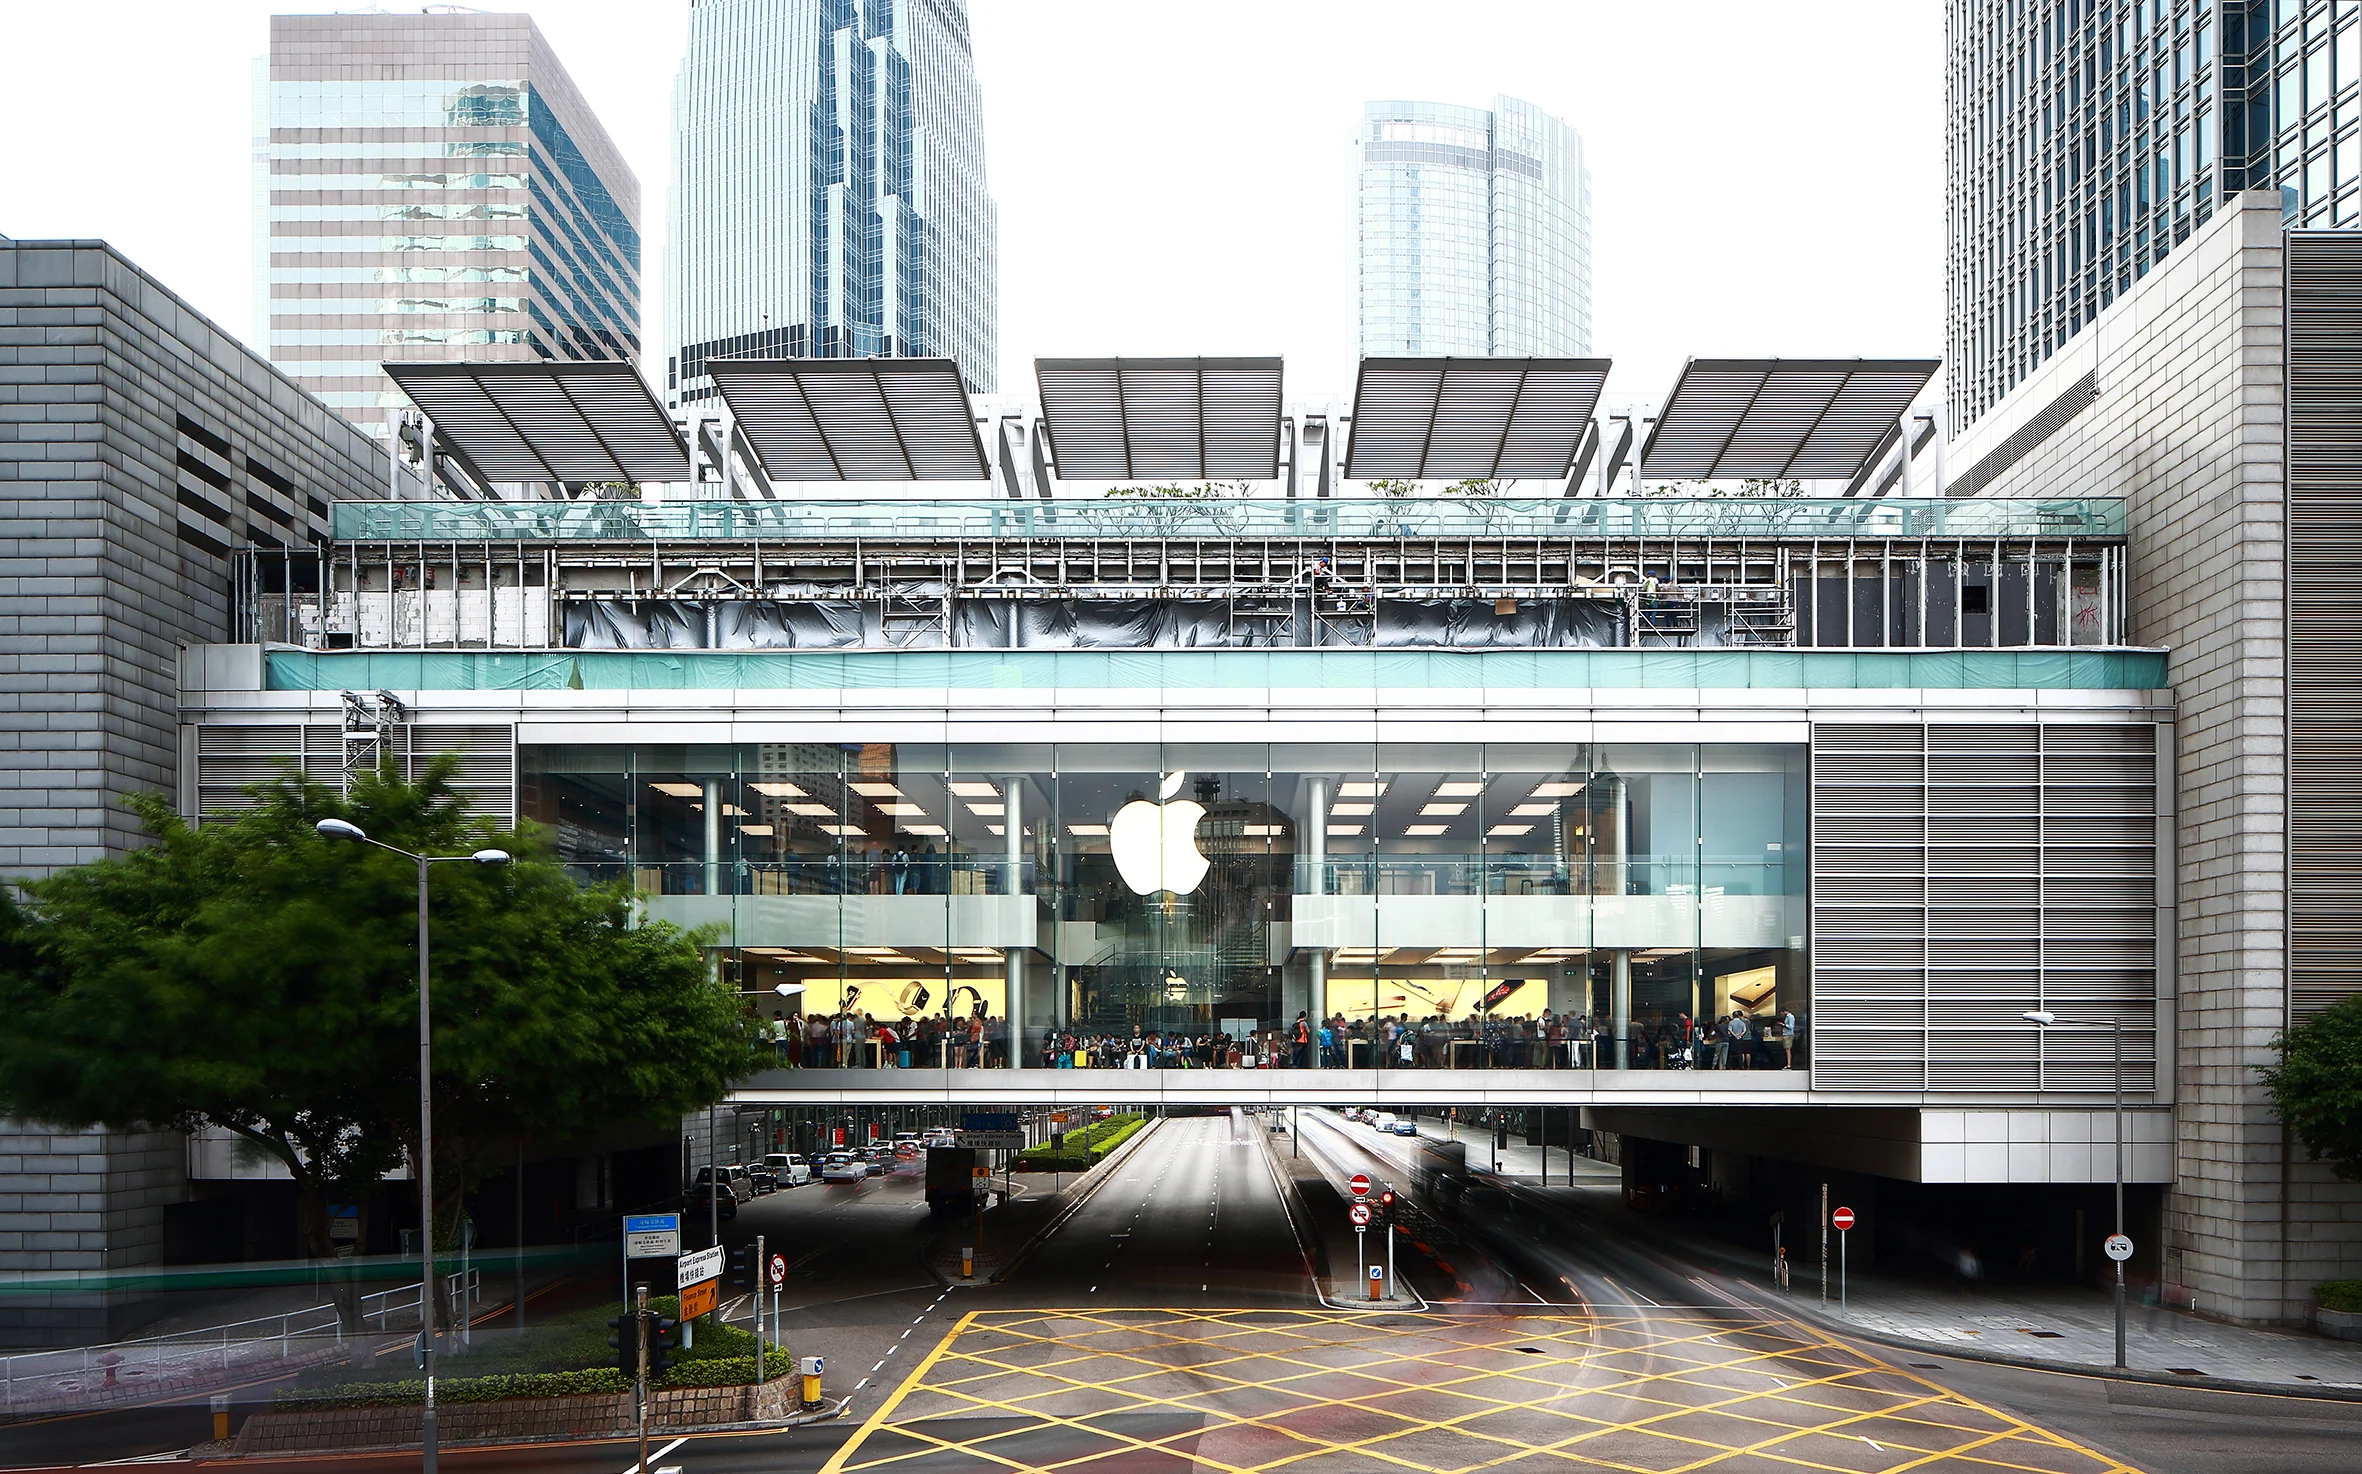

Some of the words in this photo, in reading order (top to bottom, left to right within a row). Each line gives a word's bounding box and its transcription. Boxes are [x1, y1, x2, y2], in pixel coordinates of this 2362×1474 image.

[680, 1259, 692, 1268] Airport
[692, 1254, 706, 1265] Express
[706, 1250, 719, 1260] Station
[684, 1293, 697, 1302] Finance
[697, 1287, 708, 1297] Street
